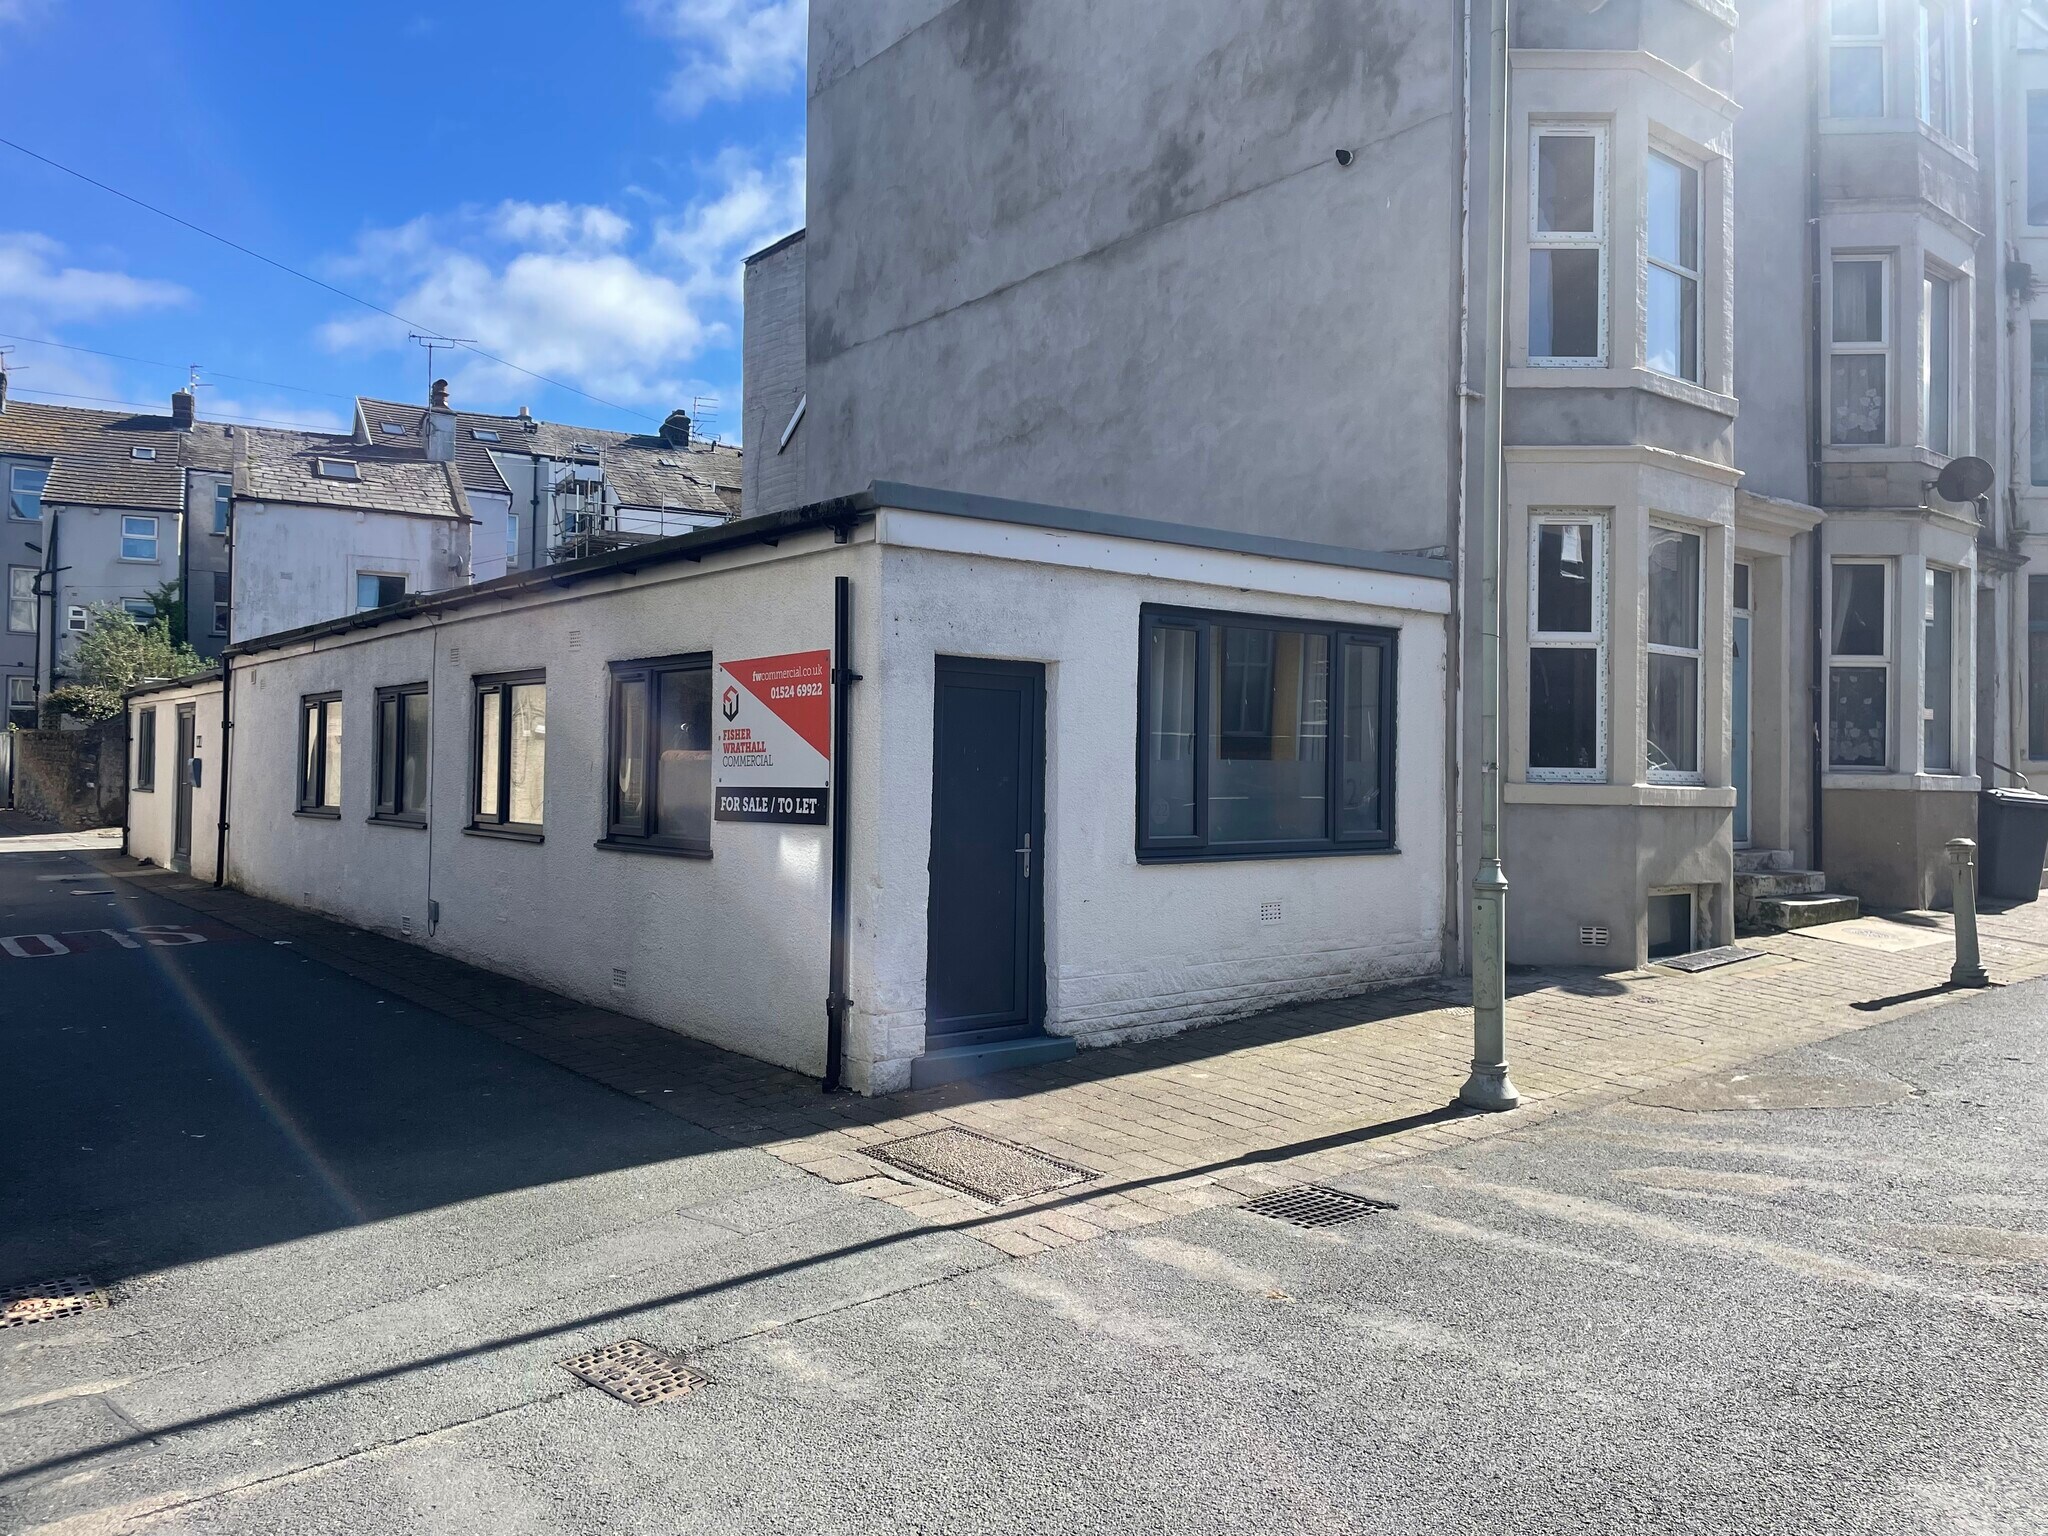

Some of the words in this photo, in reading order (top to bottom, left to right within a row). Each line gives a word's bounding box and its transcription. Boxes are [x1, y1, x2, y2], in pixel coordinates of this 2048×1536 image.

[752, 664, 823, 682] fwcommercial.co.uk
[770, 685, 795, 700] 01524
[797, 683, 823, 698] 69922
[723, 729, 751, 740] FISHER
[723, 742, 766, 753] WRATHALL
[723, 755, 773, 767] COMMERCIAL
[721, 797, 740, 811] FOR
[743, 797, 768, 812] SALE
[770, 796, 776, 813] /
[777, 797, 794, 814] TO
[795, 797, 818, 814] LET
